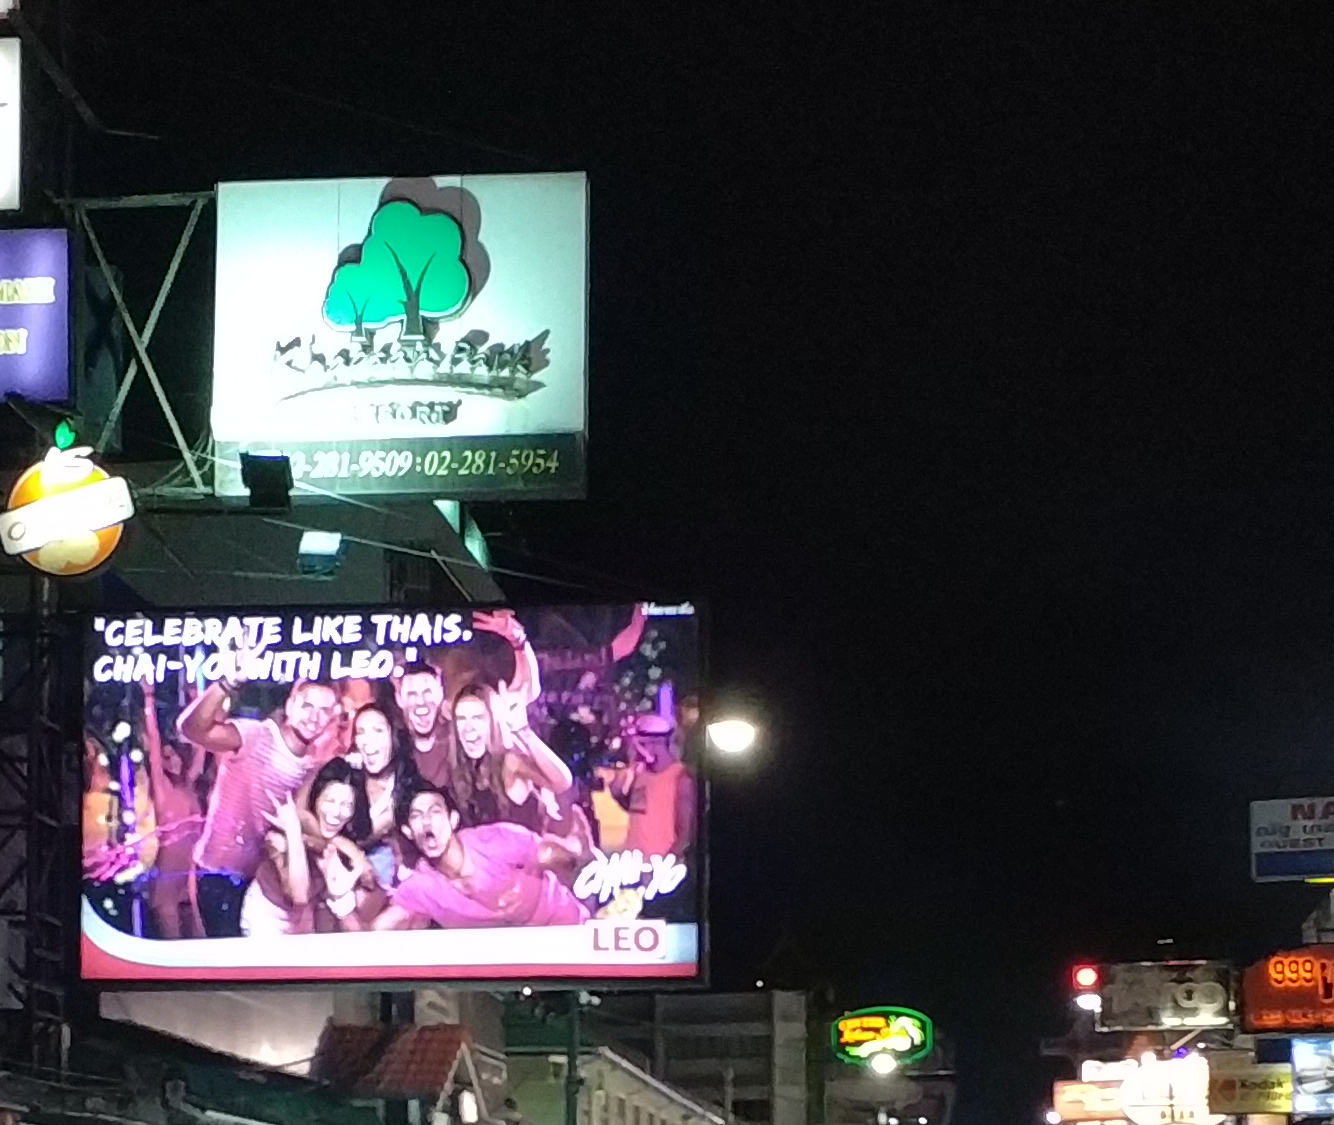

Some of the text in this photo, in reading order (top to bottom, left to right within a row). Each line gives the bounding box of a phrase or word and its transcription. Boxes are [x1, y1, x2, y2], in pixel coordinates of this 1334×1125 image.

[292, 613, 363, 646] LIKE
[371, 612, 474, 646] THAIS.
[244, 650, 321, 682] WITH
[593, 926, 659, 952] LEO
[1271, 957, 1315, 986] 999
